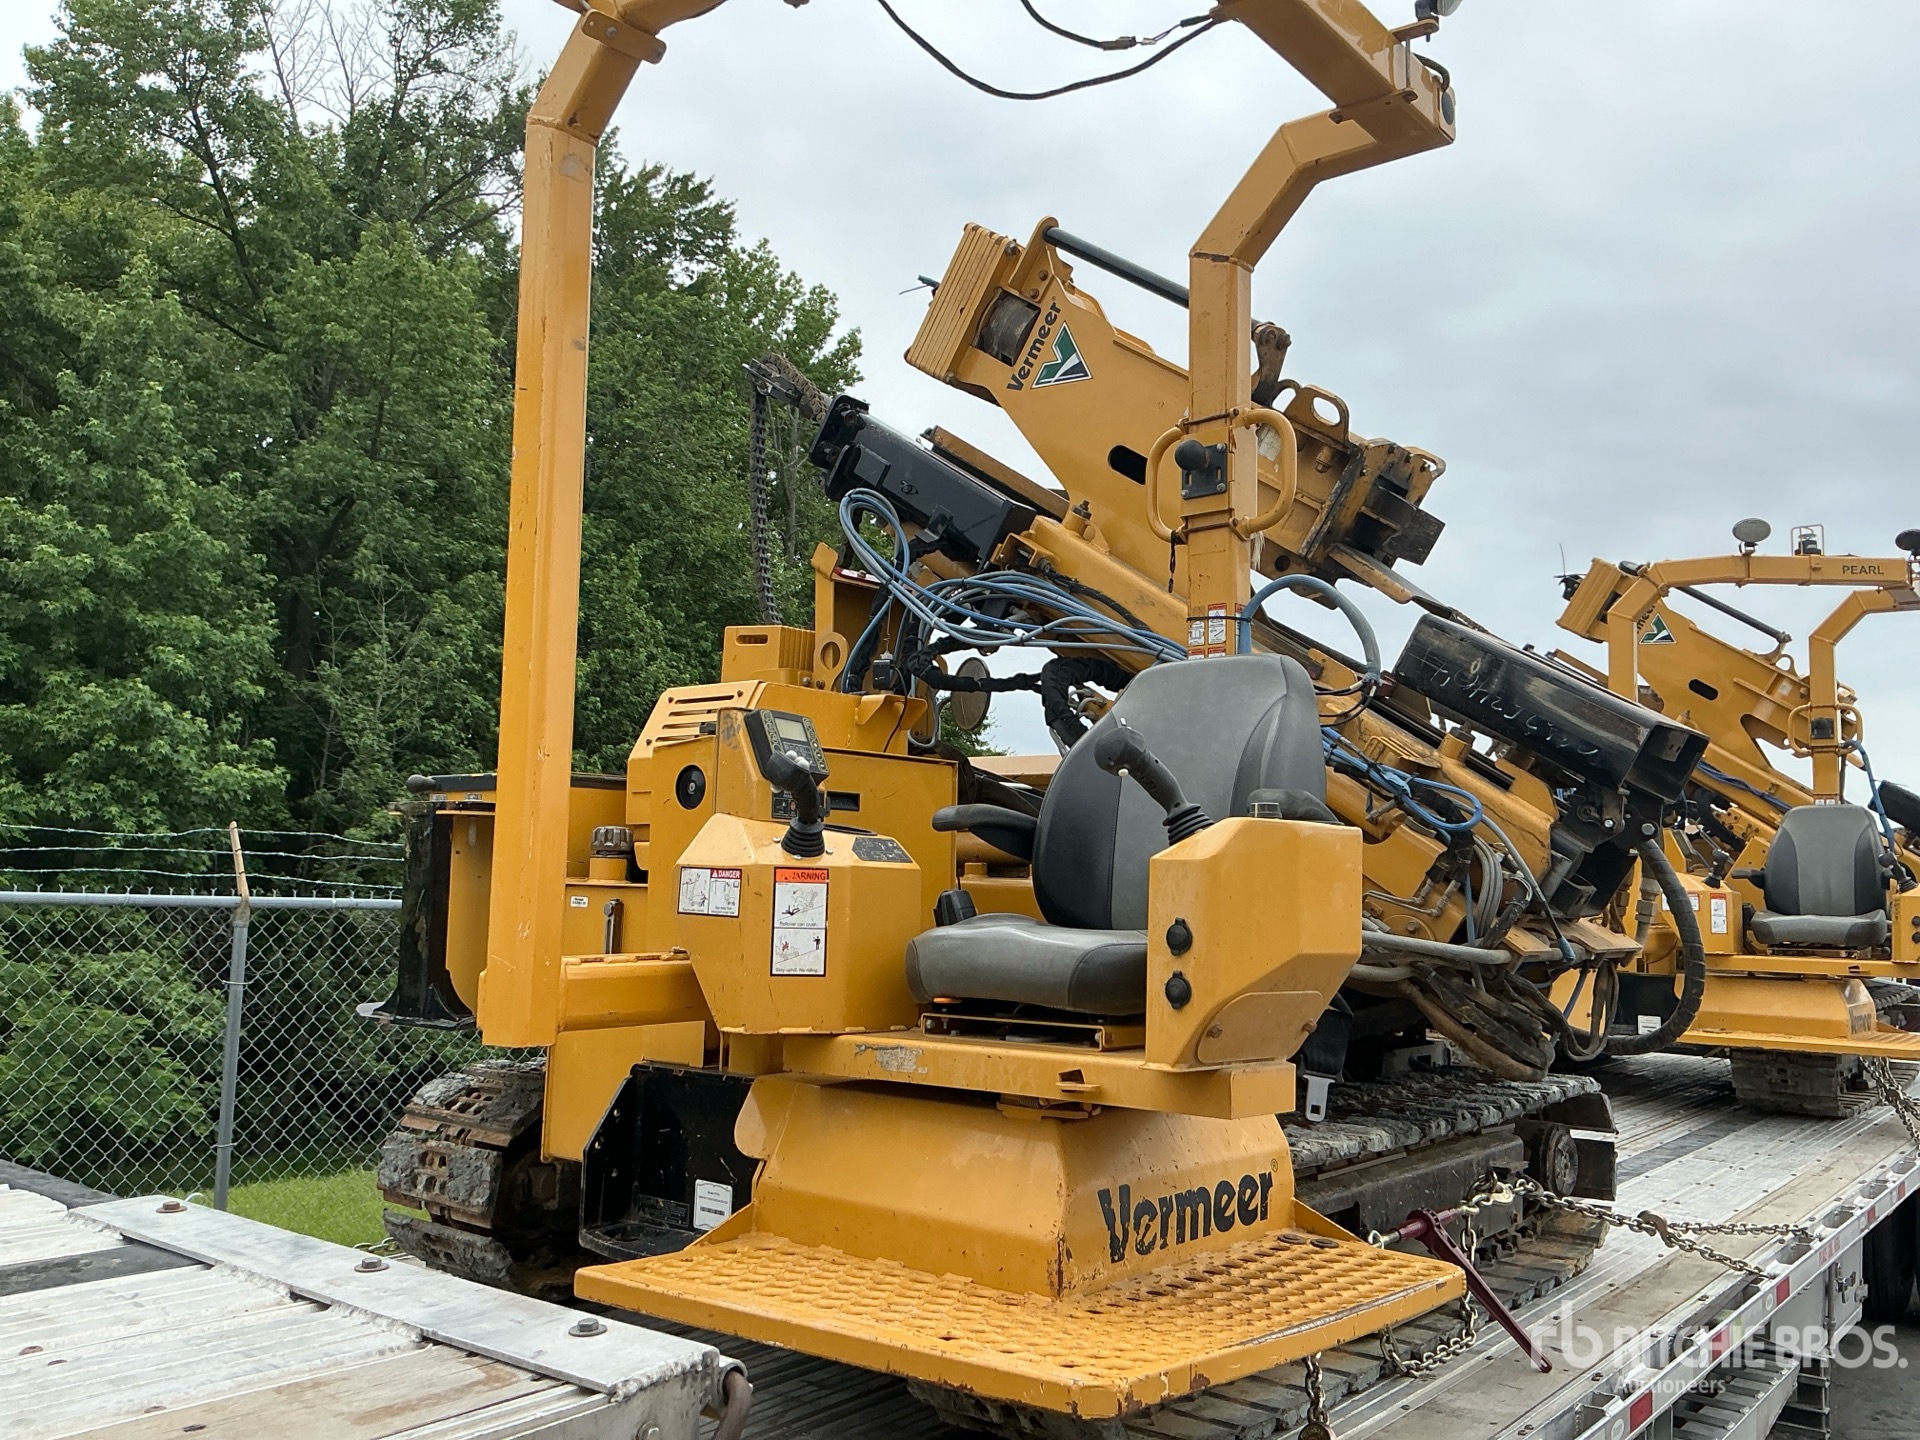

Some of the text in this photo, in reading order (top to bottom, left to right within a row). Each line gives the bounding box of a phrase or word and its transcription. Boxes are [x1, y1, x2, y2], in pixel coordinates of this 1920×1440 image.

[1006, 301, 1061, 391] Vermeer
[1842, 565, 1885, 575] PEARL
[718, 870, 741, 879] DANGER
[1097, 1171, 1273, 1264] Vermeer
